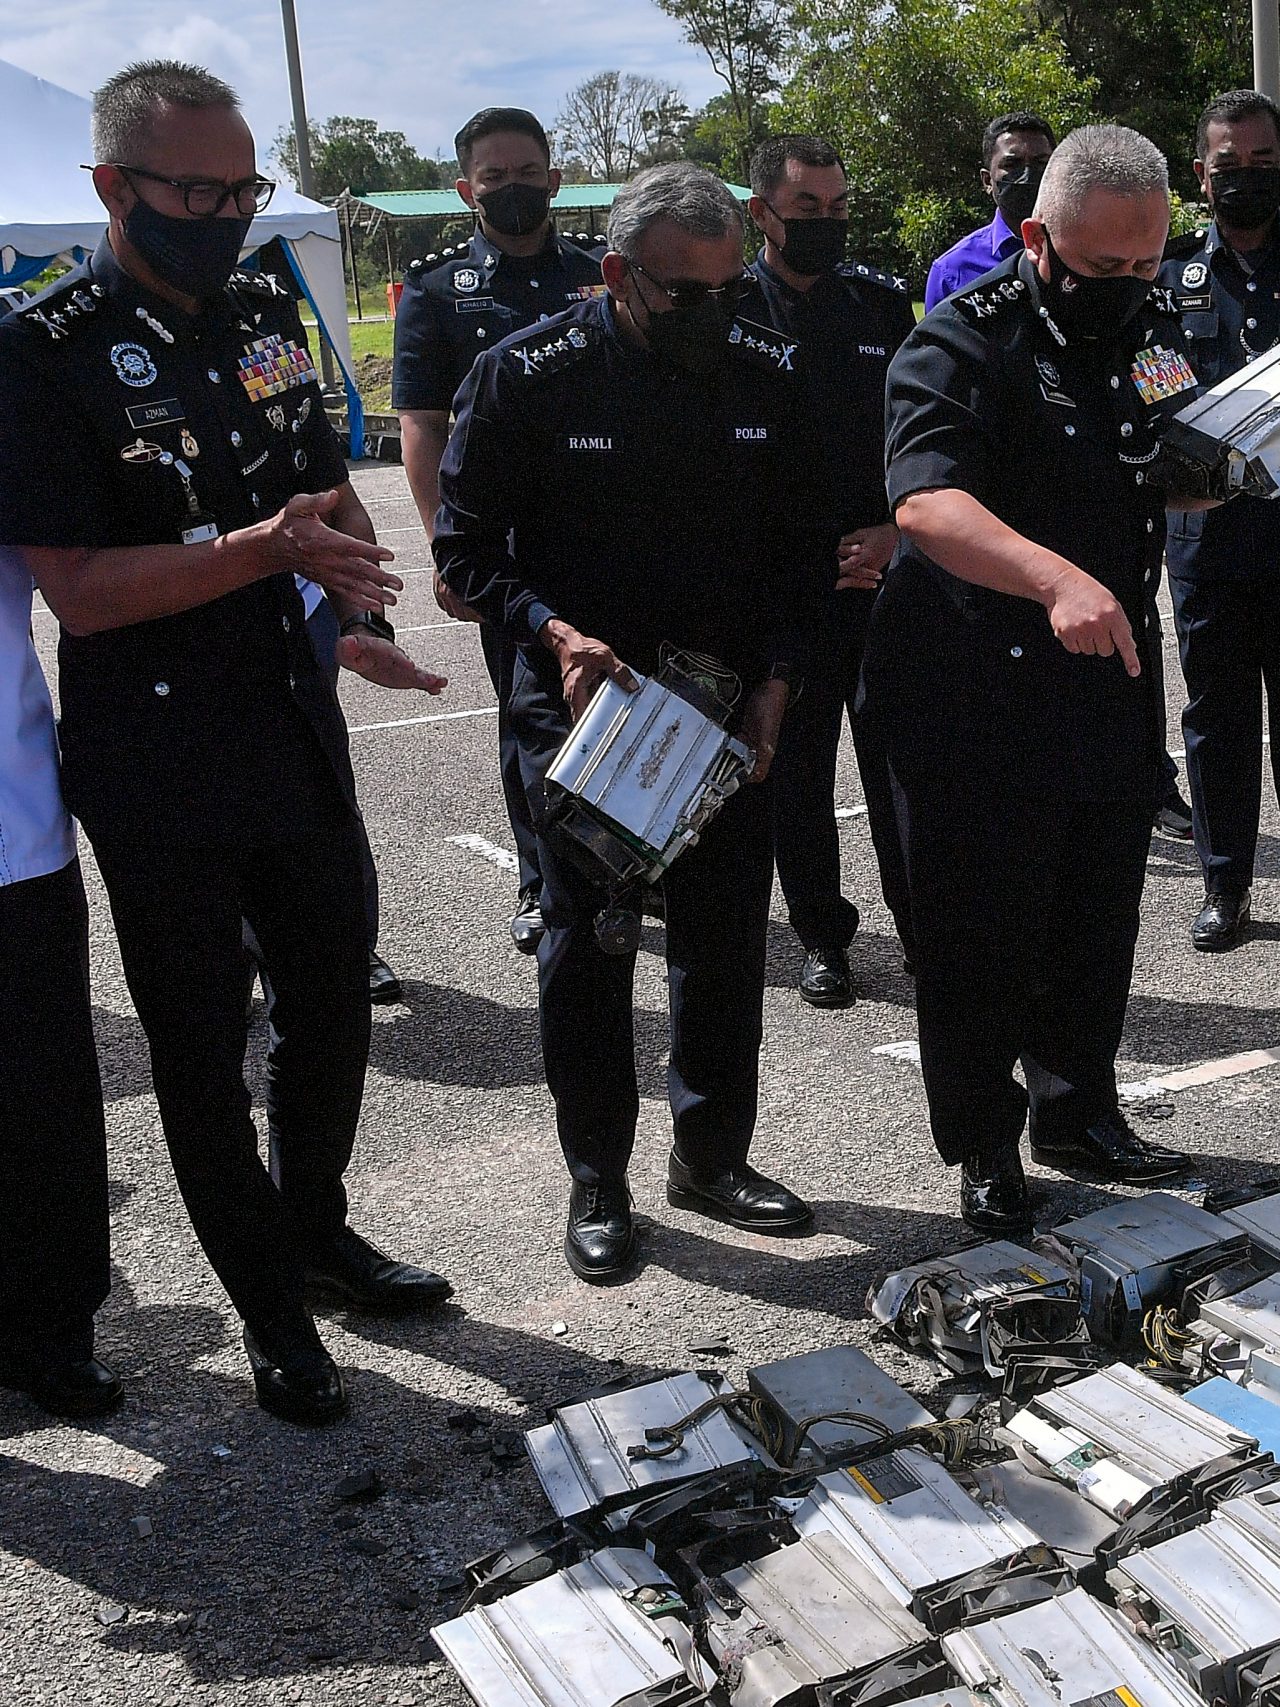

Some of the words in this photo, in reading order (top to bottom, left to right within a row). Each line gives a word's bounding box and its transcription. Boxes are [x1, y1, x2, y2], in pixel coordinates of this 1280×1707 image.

[858, 345, 886, 356] POLIS
[145, 407, 169, 421] AZMAN
[735, 427, 767, 439] POLIS
[568, 437, 613, 449] RAMLI
